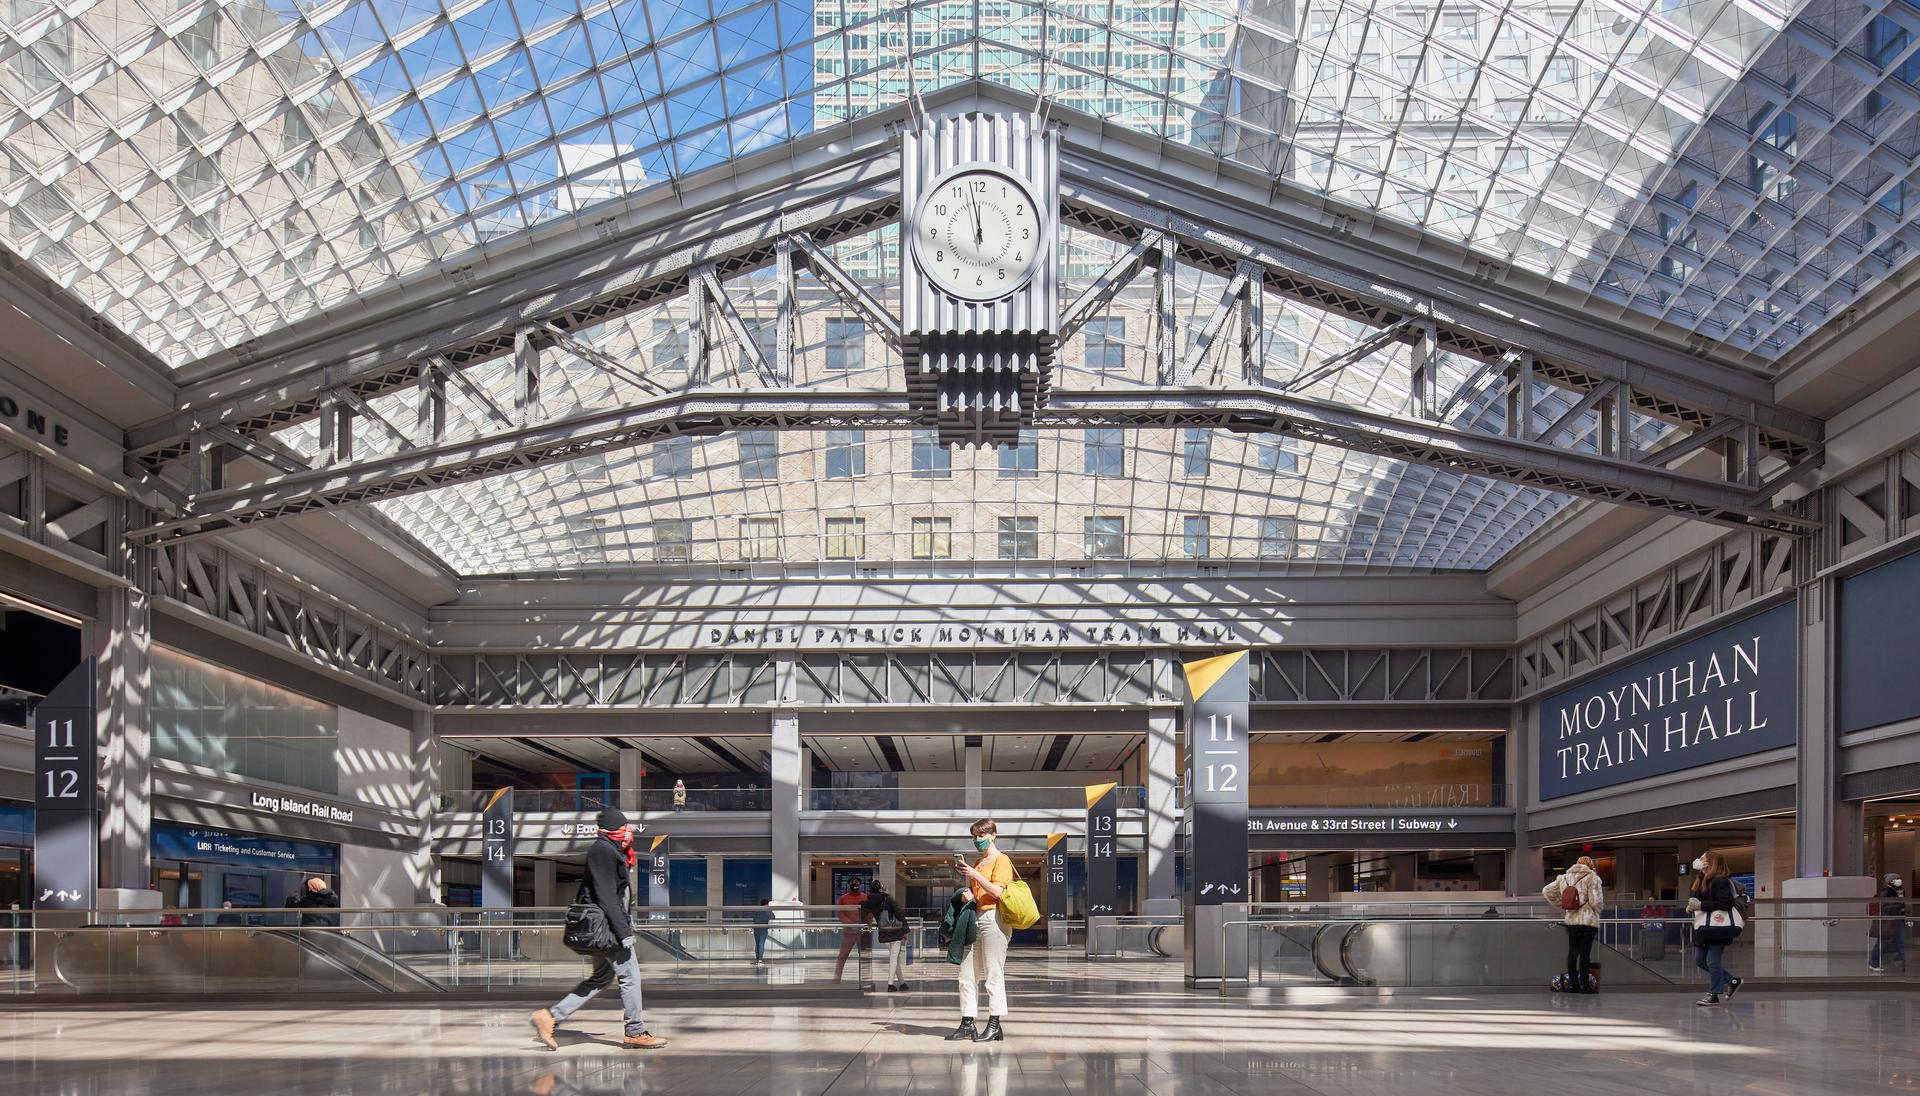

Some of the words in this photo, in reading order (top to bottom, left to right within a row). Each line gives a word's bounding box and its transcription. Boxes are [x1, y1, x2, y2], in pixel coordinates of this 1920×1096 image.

[952, 187, 962, 198] 11
[974, 181, 986, 193] 12
[1001, 187, 1007, 198] 1
[934, 204, 947, 216] 10
[1016, 204, 1023, 216] 2
[931, 228, 937, 240] 9
[1022, 228, 1029, 239] 3
[936, 250, 944, 262] 8
[1015, 251, 1022, 262] 4
[953, 268, 960, 280] 7
[998, 268, 1005, 280] 5
[976, 275, 983, 286] 6
[0, 396, 69, 447] ONE
[710, 628, 800, 643] DANIEL
[815, 628, 922, 643] PATRICK
[939, 626, 1070, 643] MOYNIHAN
[1086, 626, 1162, 643] TRAIN
[1177, 626, 1236, 642] HALL
[1559, 635, 1761, 740] MOYNIHAN
[48, 719, 75, 748] 11
[1207, 713, 1235, 742] 11
[1557, 722, 1649, 779] TRAIN
[1663, 690, 1768, 753] HALL
[1205, 763, 1238, 792] 12
[45, 770, 79, 798] 12
[252, 791, 279, 812] Long
[281, 797, 310, 815] Island
[312, 803, 329, 818] Rail
[331, 807, 353, 822] Road
[488, 819, 505, 835] 13
[1095, 816, 1112, 831] 13
[1266, 819, 1308, 830] Avenue
[1310, 819, 1320, 830] &
[1322, 819, 1347, 830] 33rd
[1350, 819, 1386, 830] Street
[1398, 819, 1442, 832] Subway
[197, 841, 212, 851] LIRR
[214, 844, 239, 855] Ticketing
[240, 847, 251, 855] and
[251, 848, 276, 858] Customer
[277, 850, 295, 860] Service
[487, 846, 506, 861] 14
[1094, 842, 1112, 858] 14
[653, 856, 665, 867] 15
[1052, 854, 1064, 866] 15
[653, 873, 665, 885] 16
[1052, 871, 1064, 883] 16
